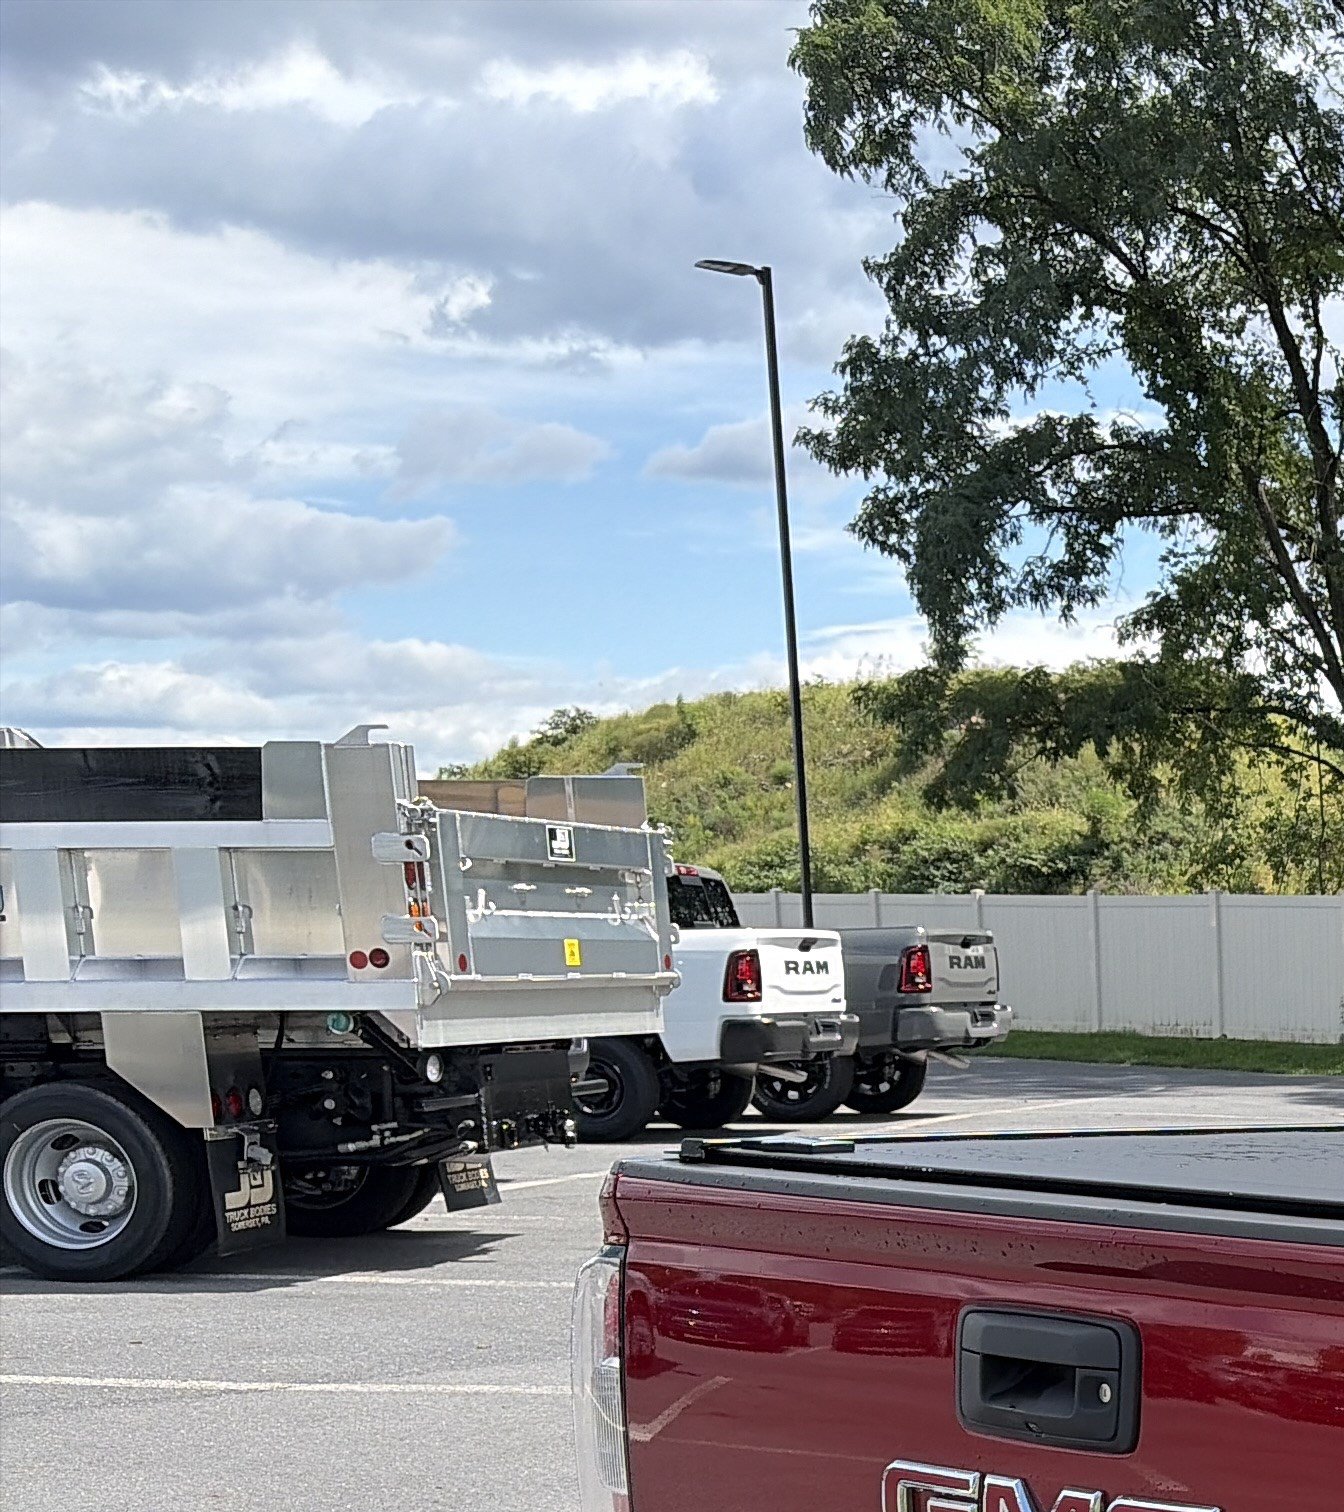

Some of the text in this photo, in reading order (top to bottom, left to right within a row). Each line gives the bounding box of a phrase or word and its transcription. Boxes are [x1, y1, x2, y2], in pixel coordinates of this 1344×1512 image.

[784, 960, 830, 975] RAM
[948, 955, 986, 970] RAM
[225, 1203, 277, 1224] TRUCK BODIES
